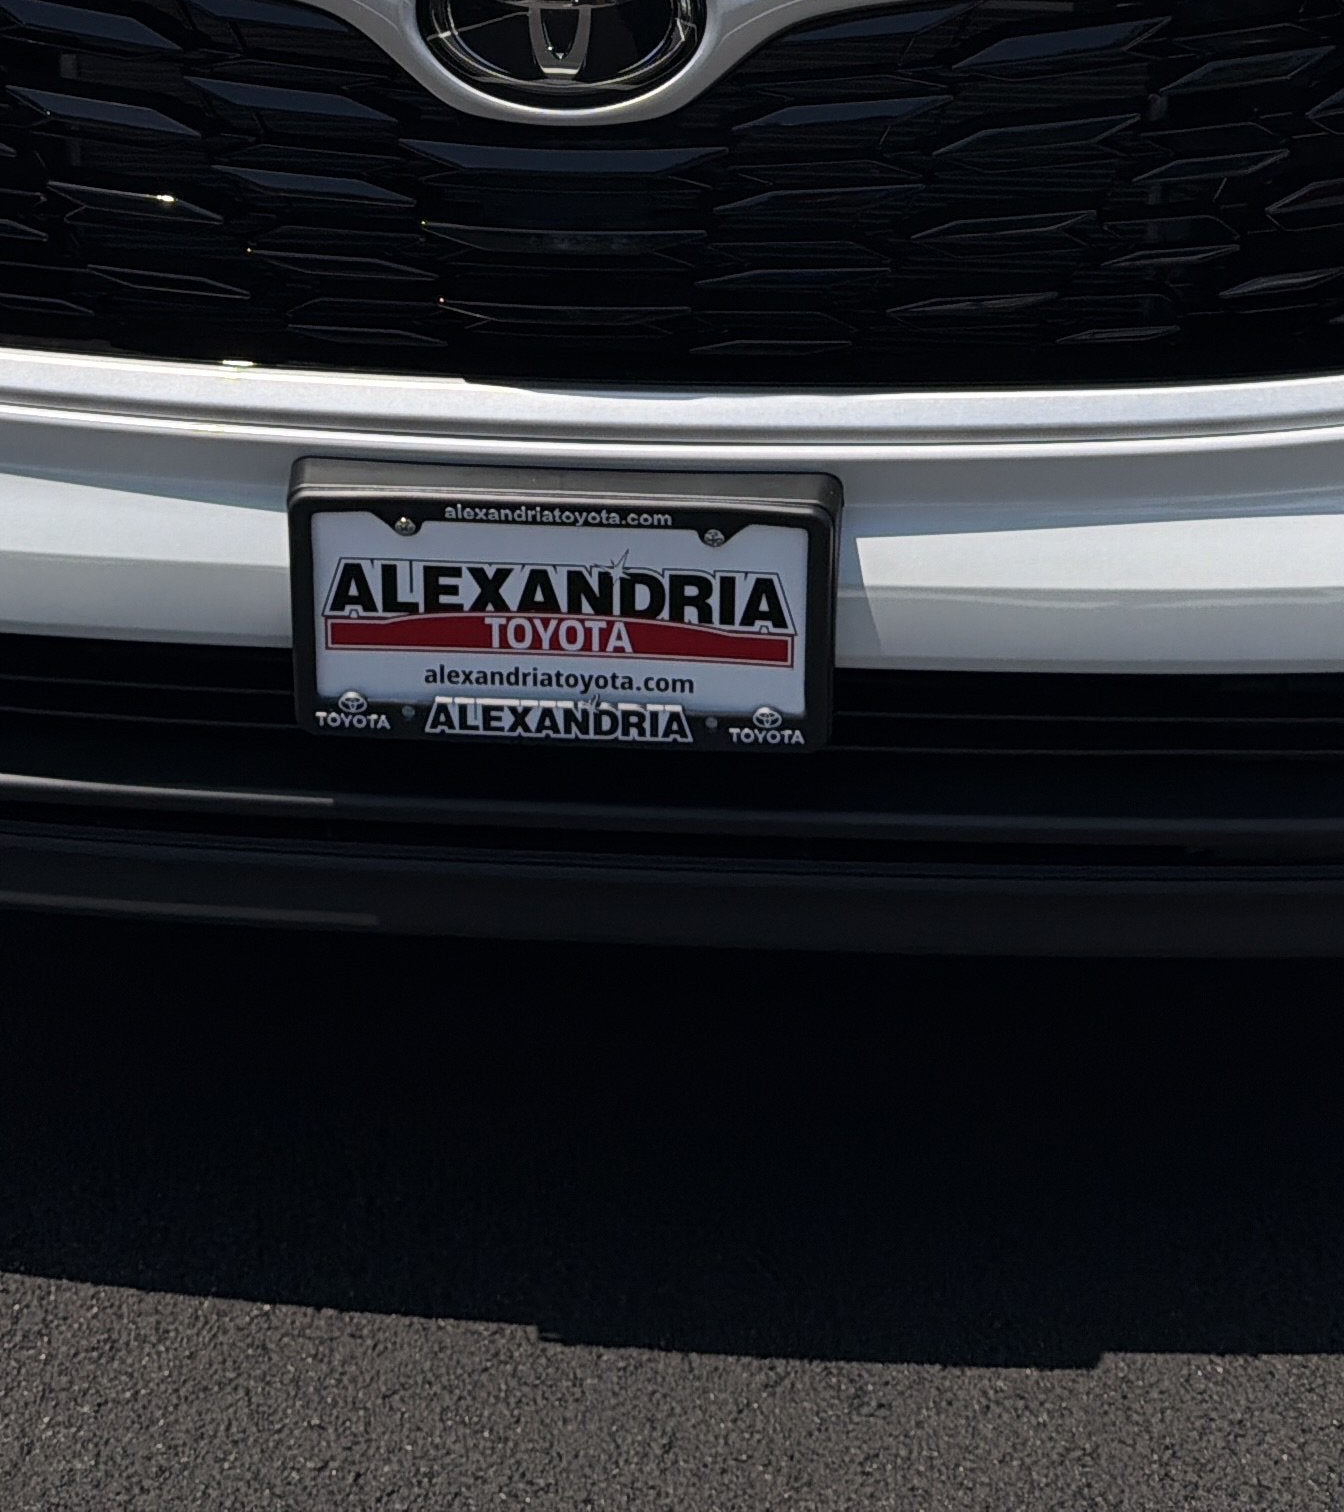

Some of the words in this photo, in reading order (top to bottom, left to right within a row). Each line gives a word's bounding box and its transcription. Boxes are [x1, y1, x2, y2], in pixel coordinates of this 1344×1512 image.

[444, 502, 674, 527] alexandriatoyota.com
[326, 560, 793, 631] ALEXANDRIA
[483, 616, 635, 654] TOYOTA
[424, 663, 695, 694] alexandriatoyota.com
[315, 711, 391, 731] TOYOTA
[425, 697, 693, 742] ALEXANDRIA
[728, 726, 806, 745] TOYOTA
